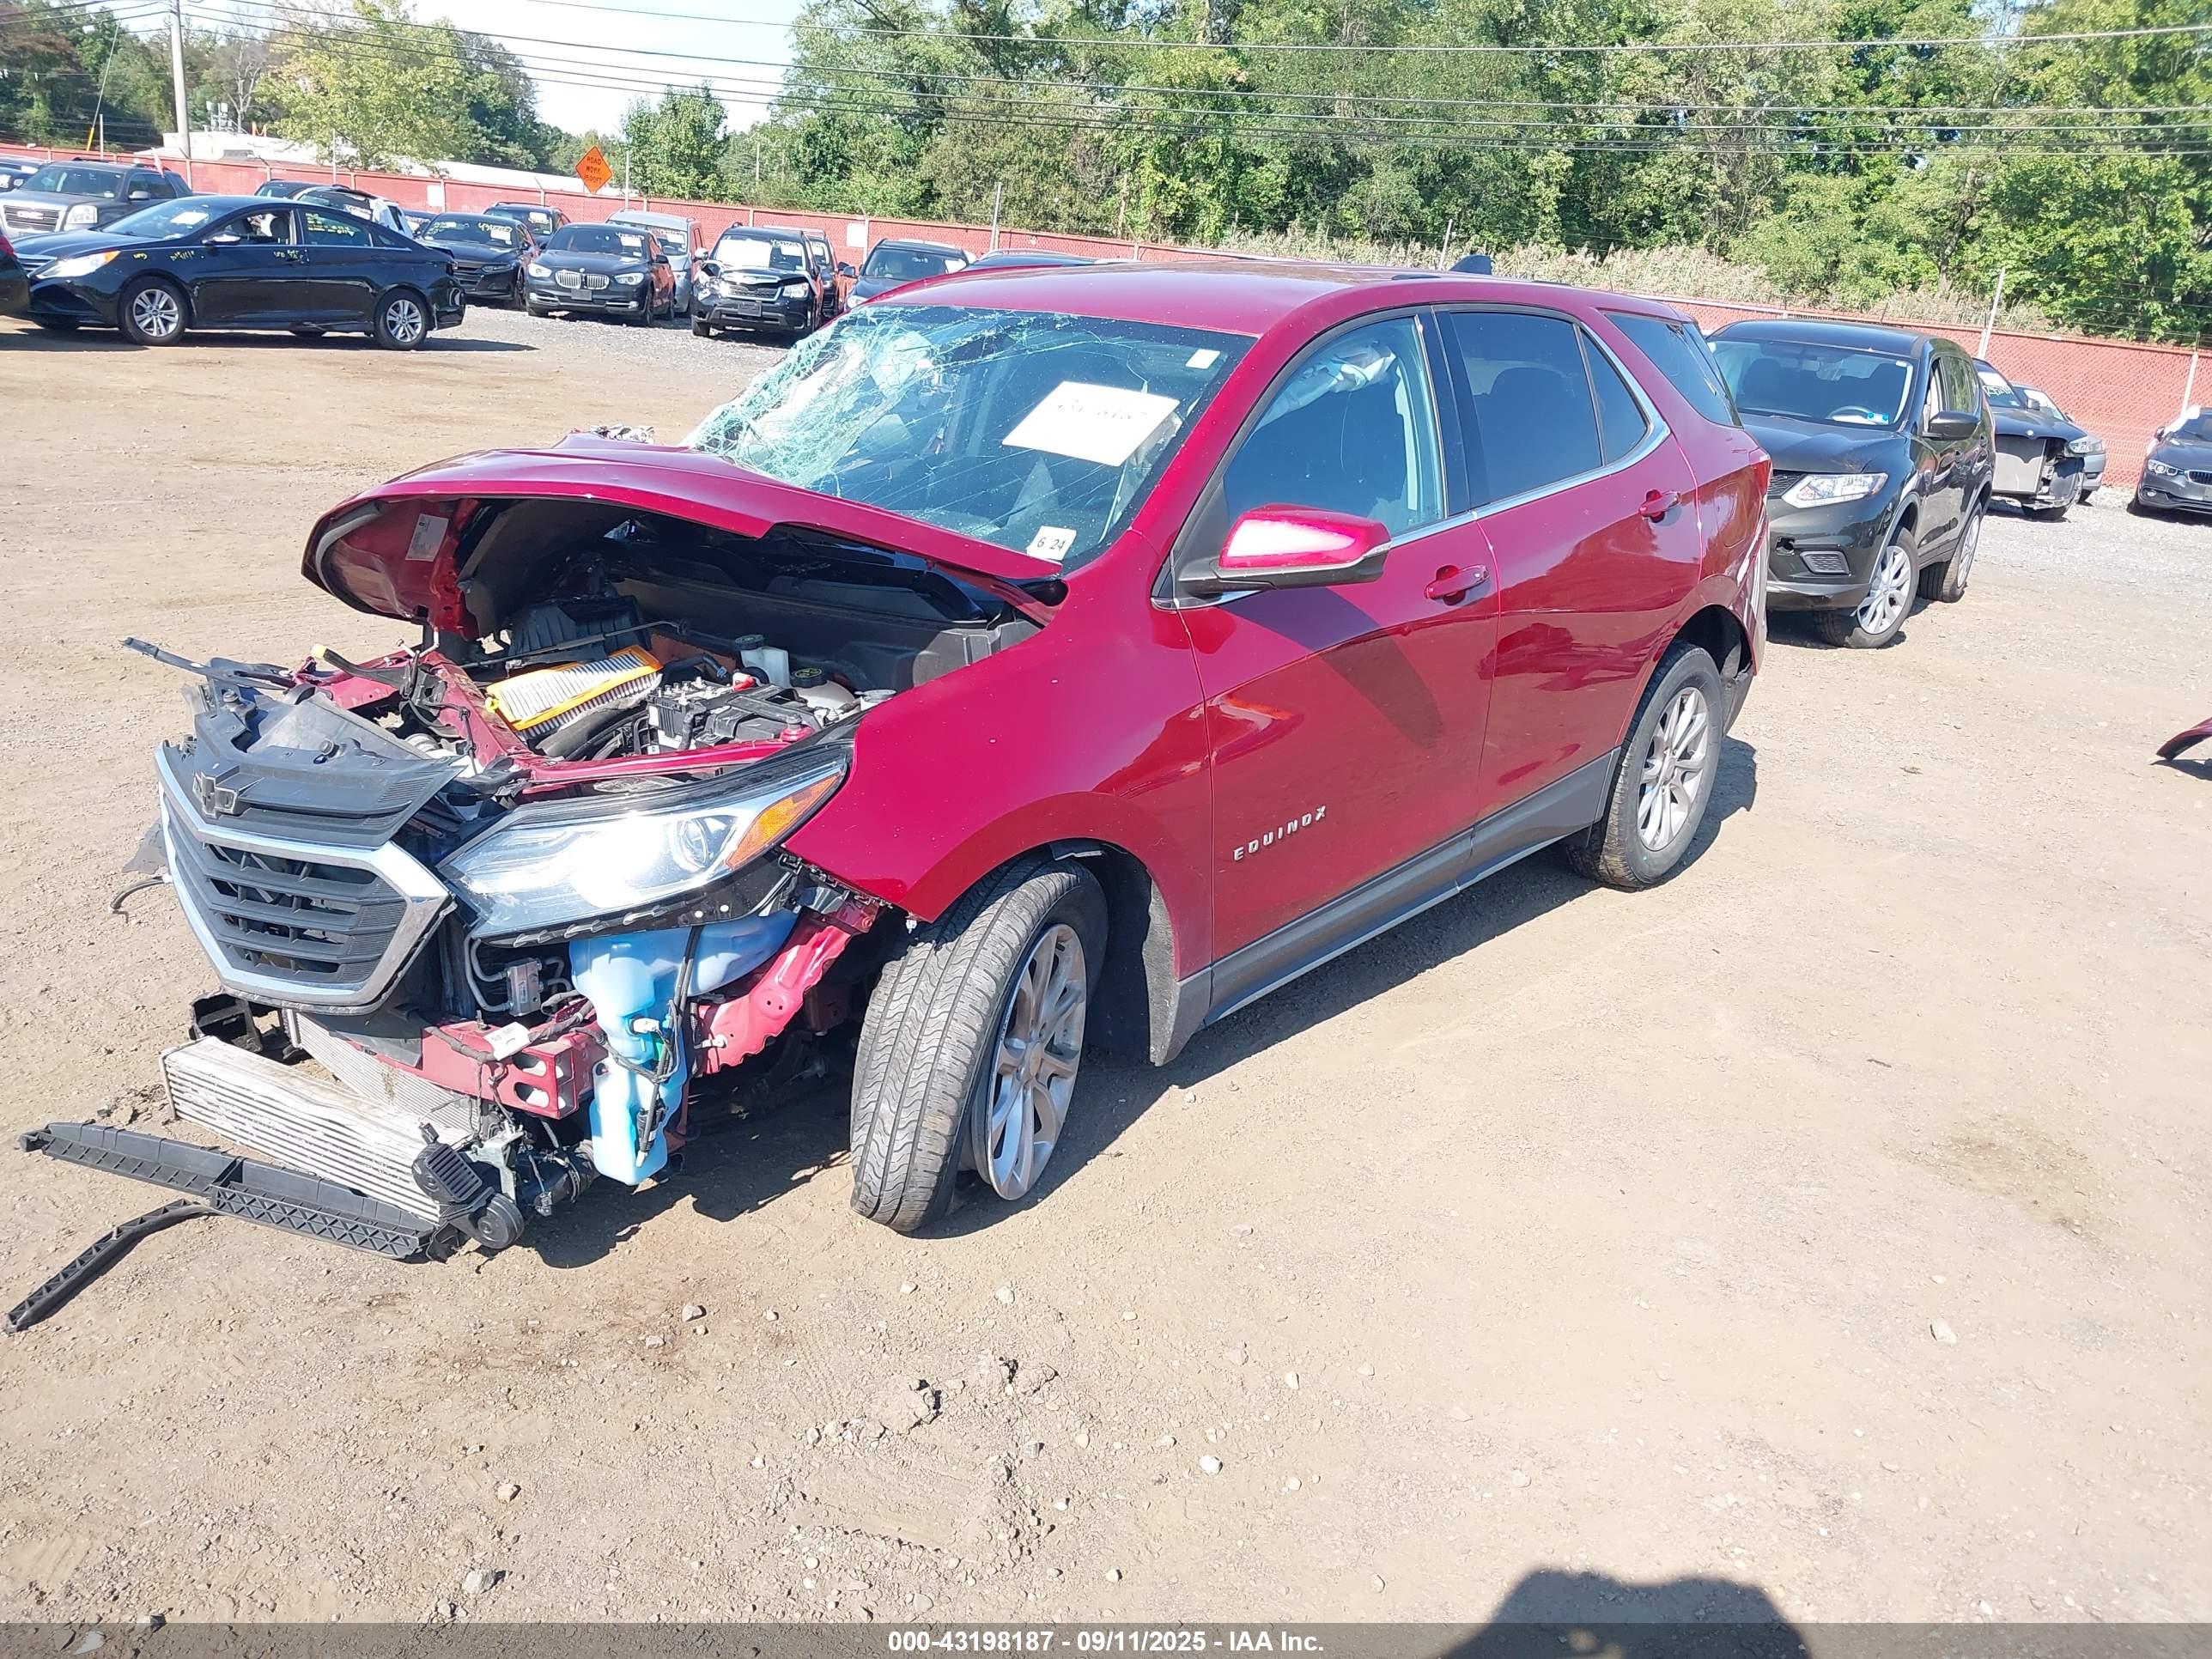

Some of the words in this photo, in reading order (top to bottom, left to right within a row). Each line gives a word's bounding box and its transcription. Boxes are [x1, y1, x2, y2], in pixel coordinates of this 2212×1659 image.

[586, 156, 601, 165] ROAD
[586, 166, 601, 175] WORK
[1037, 537, 1047, 548] 6
[1049, 538, 1066, 551] 24
[1233, 805, 1326, 861] EQUINOX
